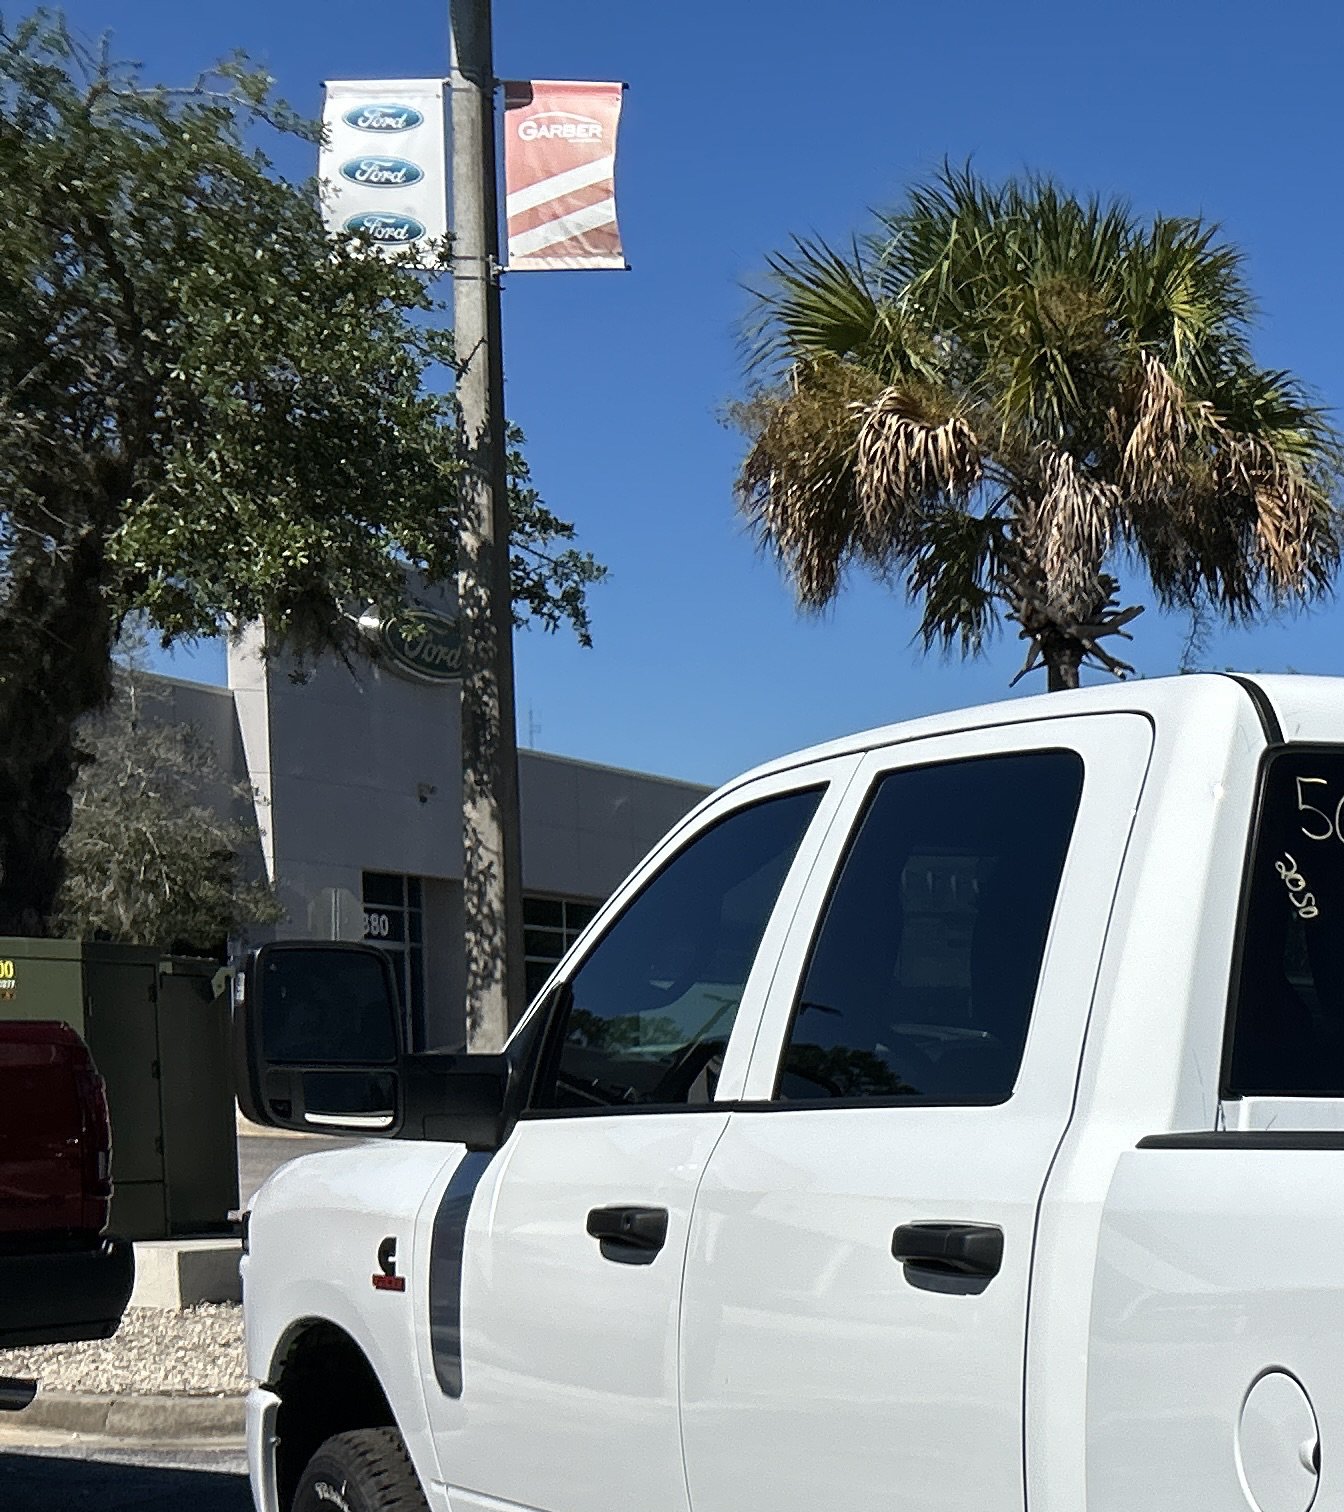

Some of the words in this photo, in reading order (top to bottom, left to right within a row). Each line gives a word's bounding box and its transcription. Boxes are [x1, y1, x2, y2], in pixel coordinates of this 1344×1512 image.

[357, 107, 408, 129] Ford
[517, 120, 603, 141] GARBER
[354, 159, 407, 183] Ford
[359, 216, 409, 240] Ford
[1275, 852, 1319, 918] 2050
